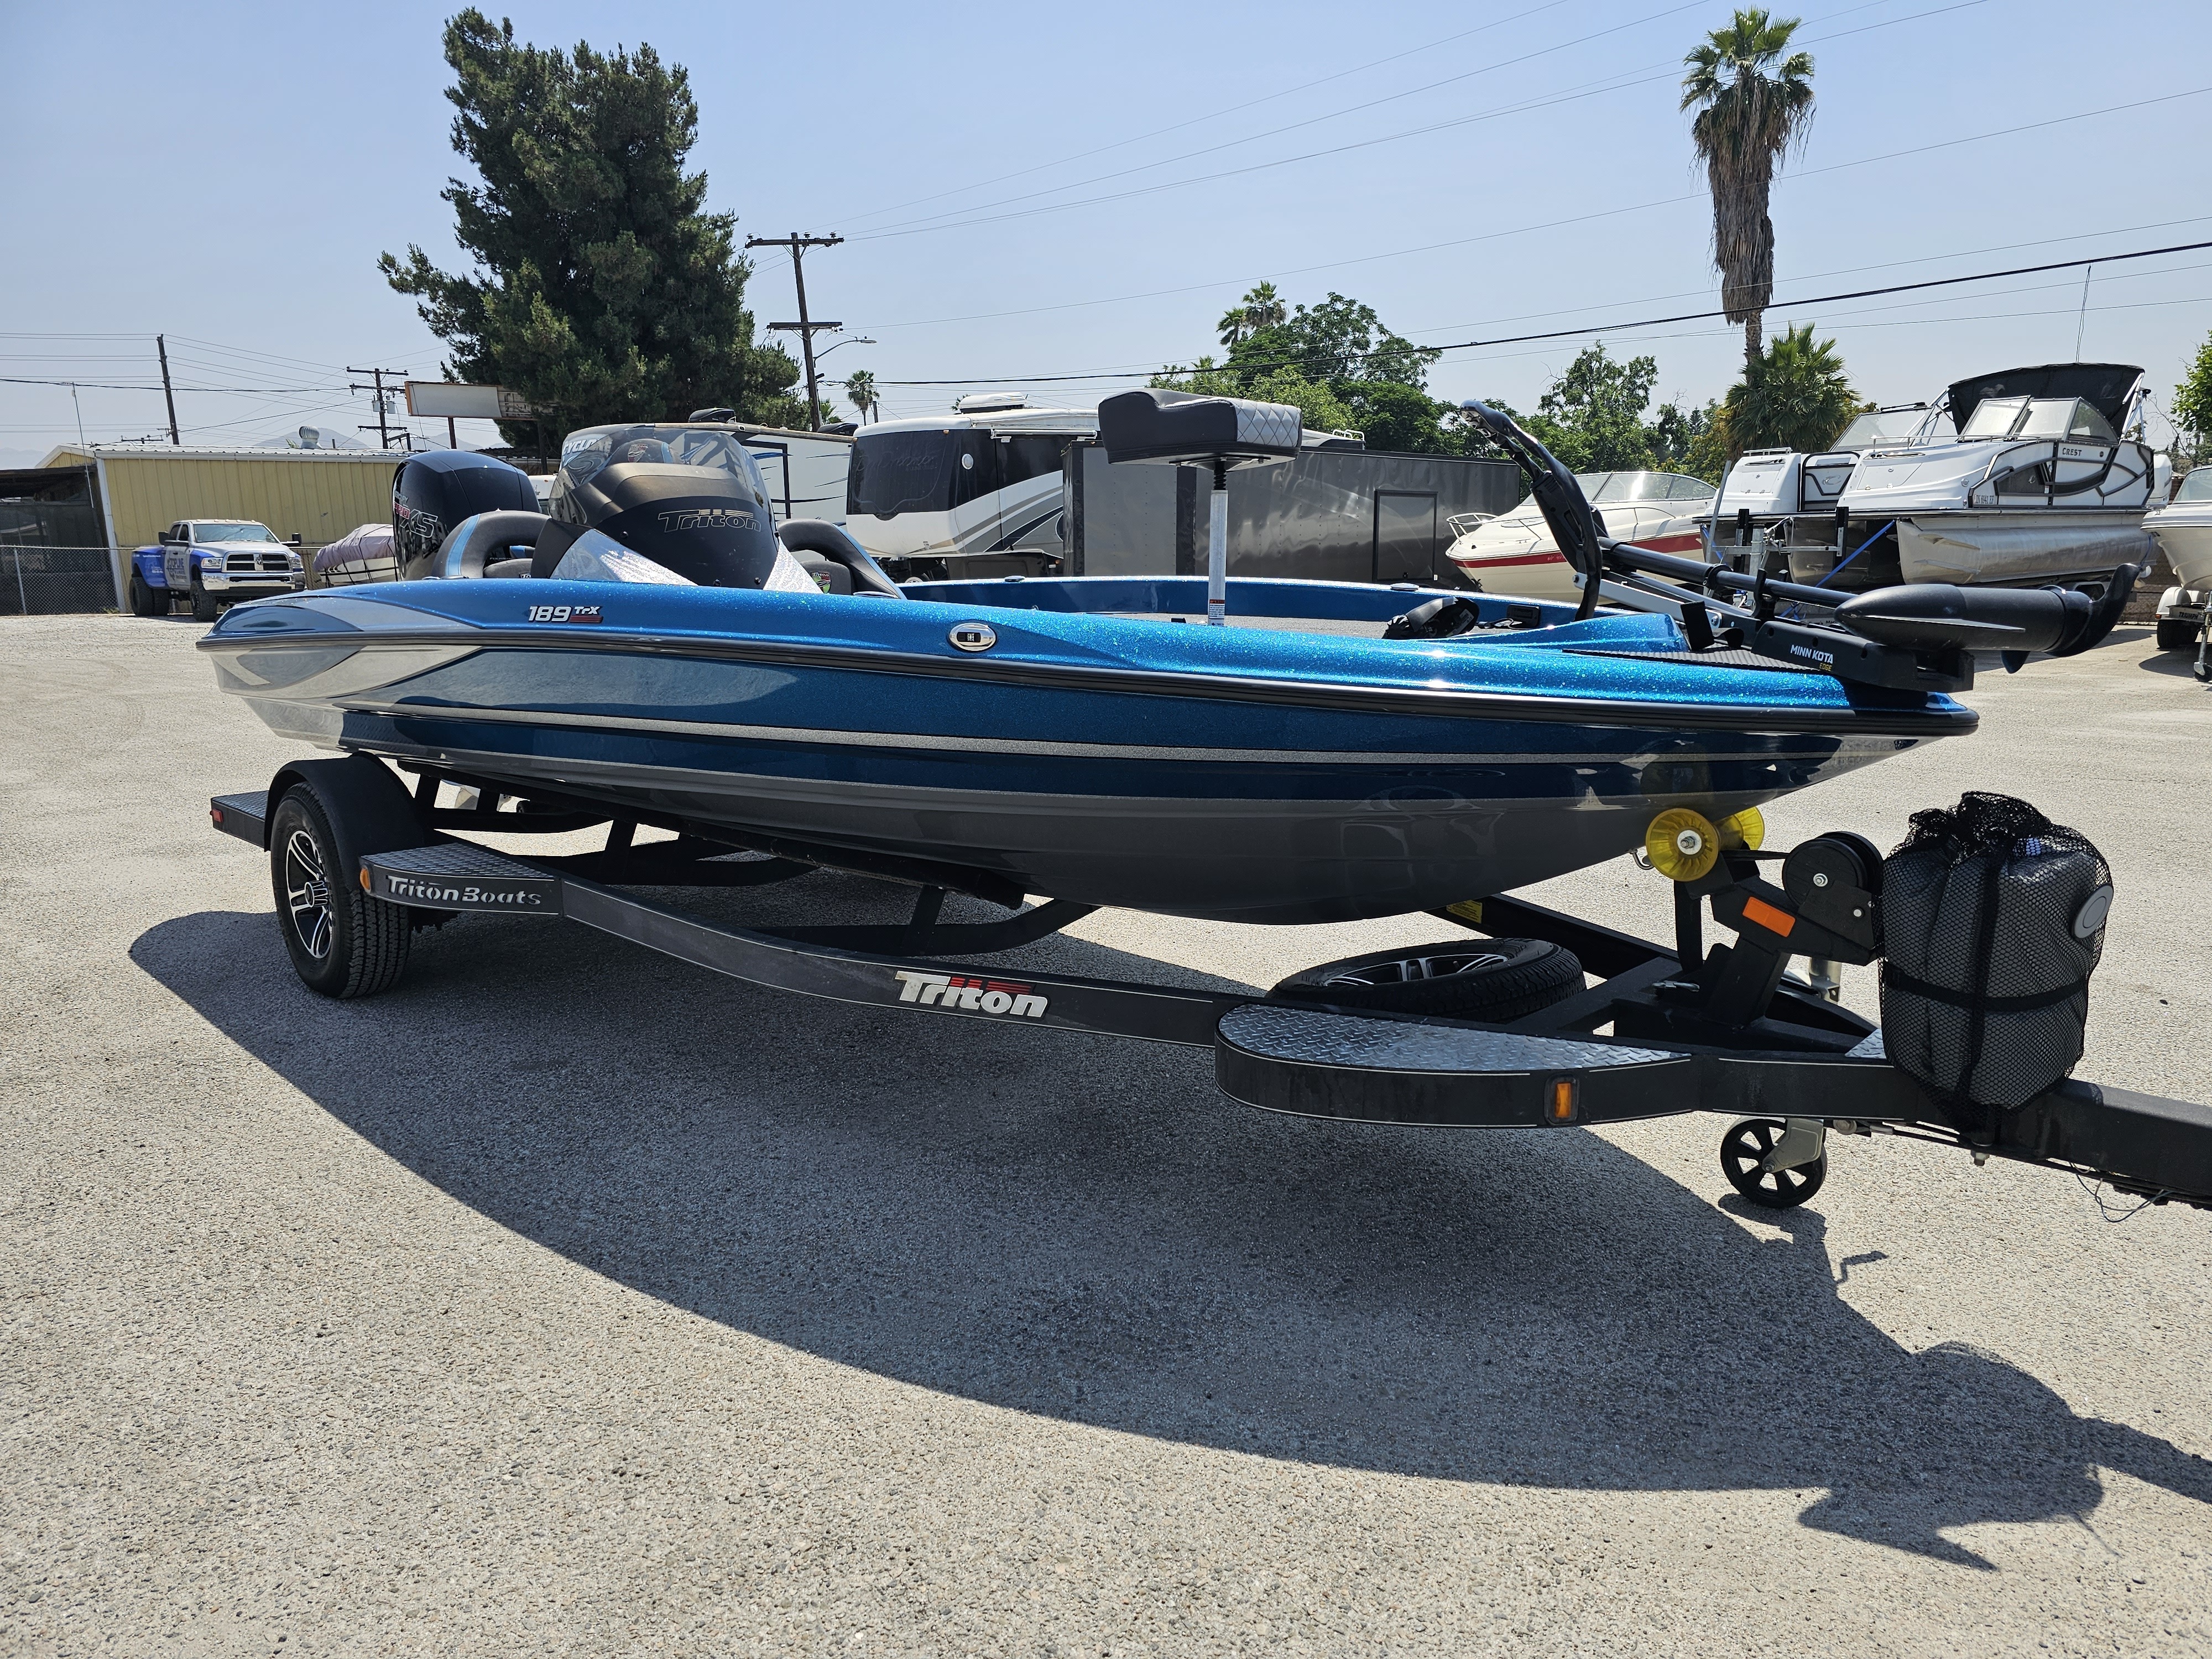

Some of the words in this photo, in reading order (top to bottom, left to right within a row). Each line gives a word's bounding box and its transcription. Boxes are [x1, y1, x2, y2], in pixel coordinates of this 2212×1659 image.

[2062, 447, 2082, 456] CREST
[400, 509, 439, 538] XS
[658, 509, 761, 533] Triton
[528, 606, 572, 621] 189
[1791, 645, 1812, 658] MINN
[1812, 650, 1833, 664] KOTA
[894, 971, 1048, 1018] Triton
